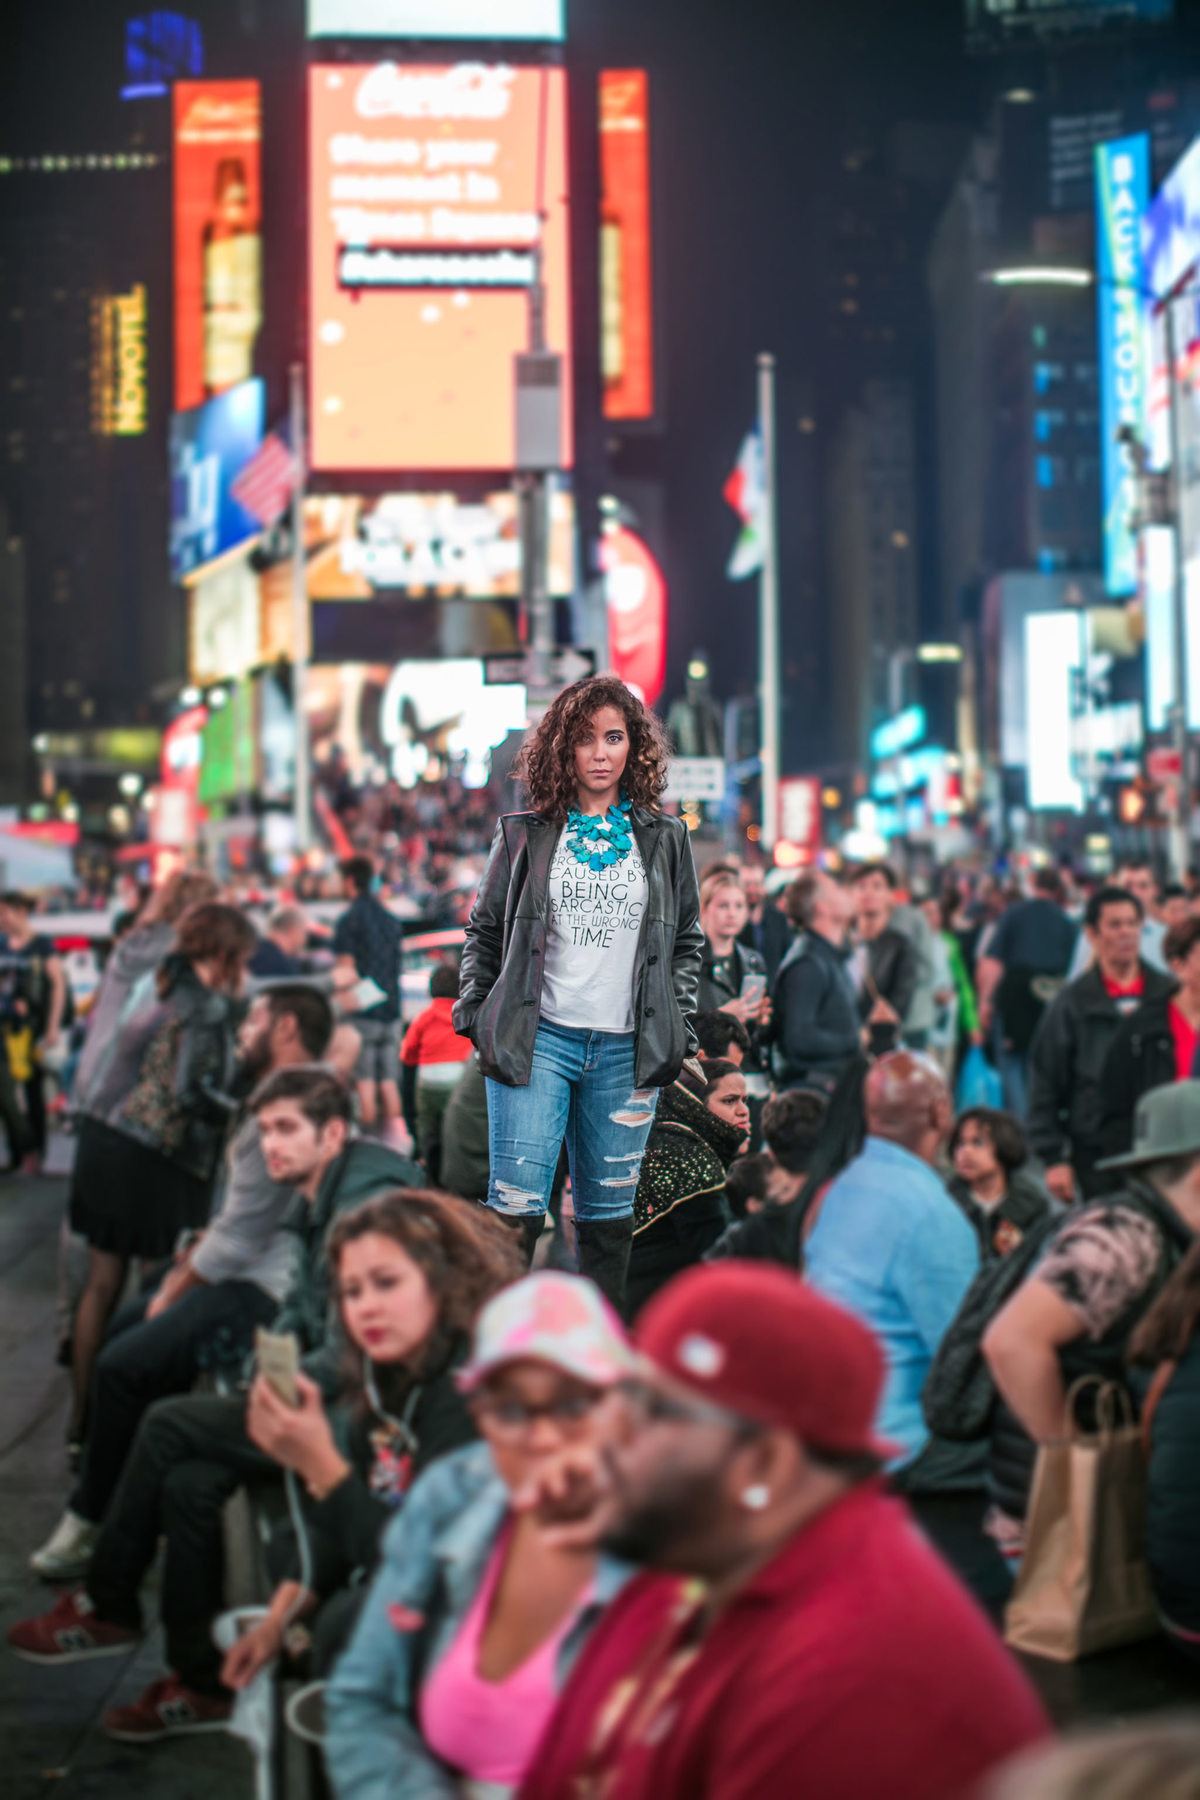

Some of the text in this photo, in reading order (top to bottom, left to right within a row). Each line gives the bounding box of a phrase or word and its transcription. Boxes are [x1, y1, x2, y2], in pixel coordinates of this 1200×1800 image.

[549, 867, 647, 883] CAUSED BY
[562, 881, 629, 900] BEING
[551, 898, 643, 917] SARCASTIC
[551, 914, 641, 930] AT THE WRONG
[571, 926, 615, 948] TIME
